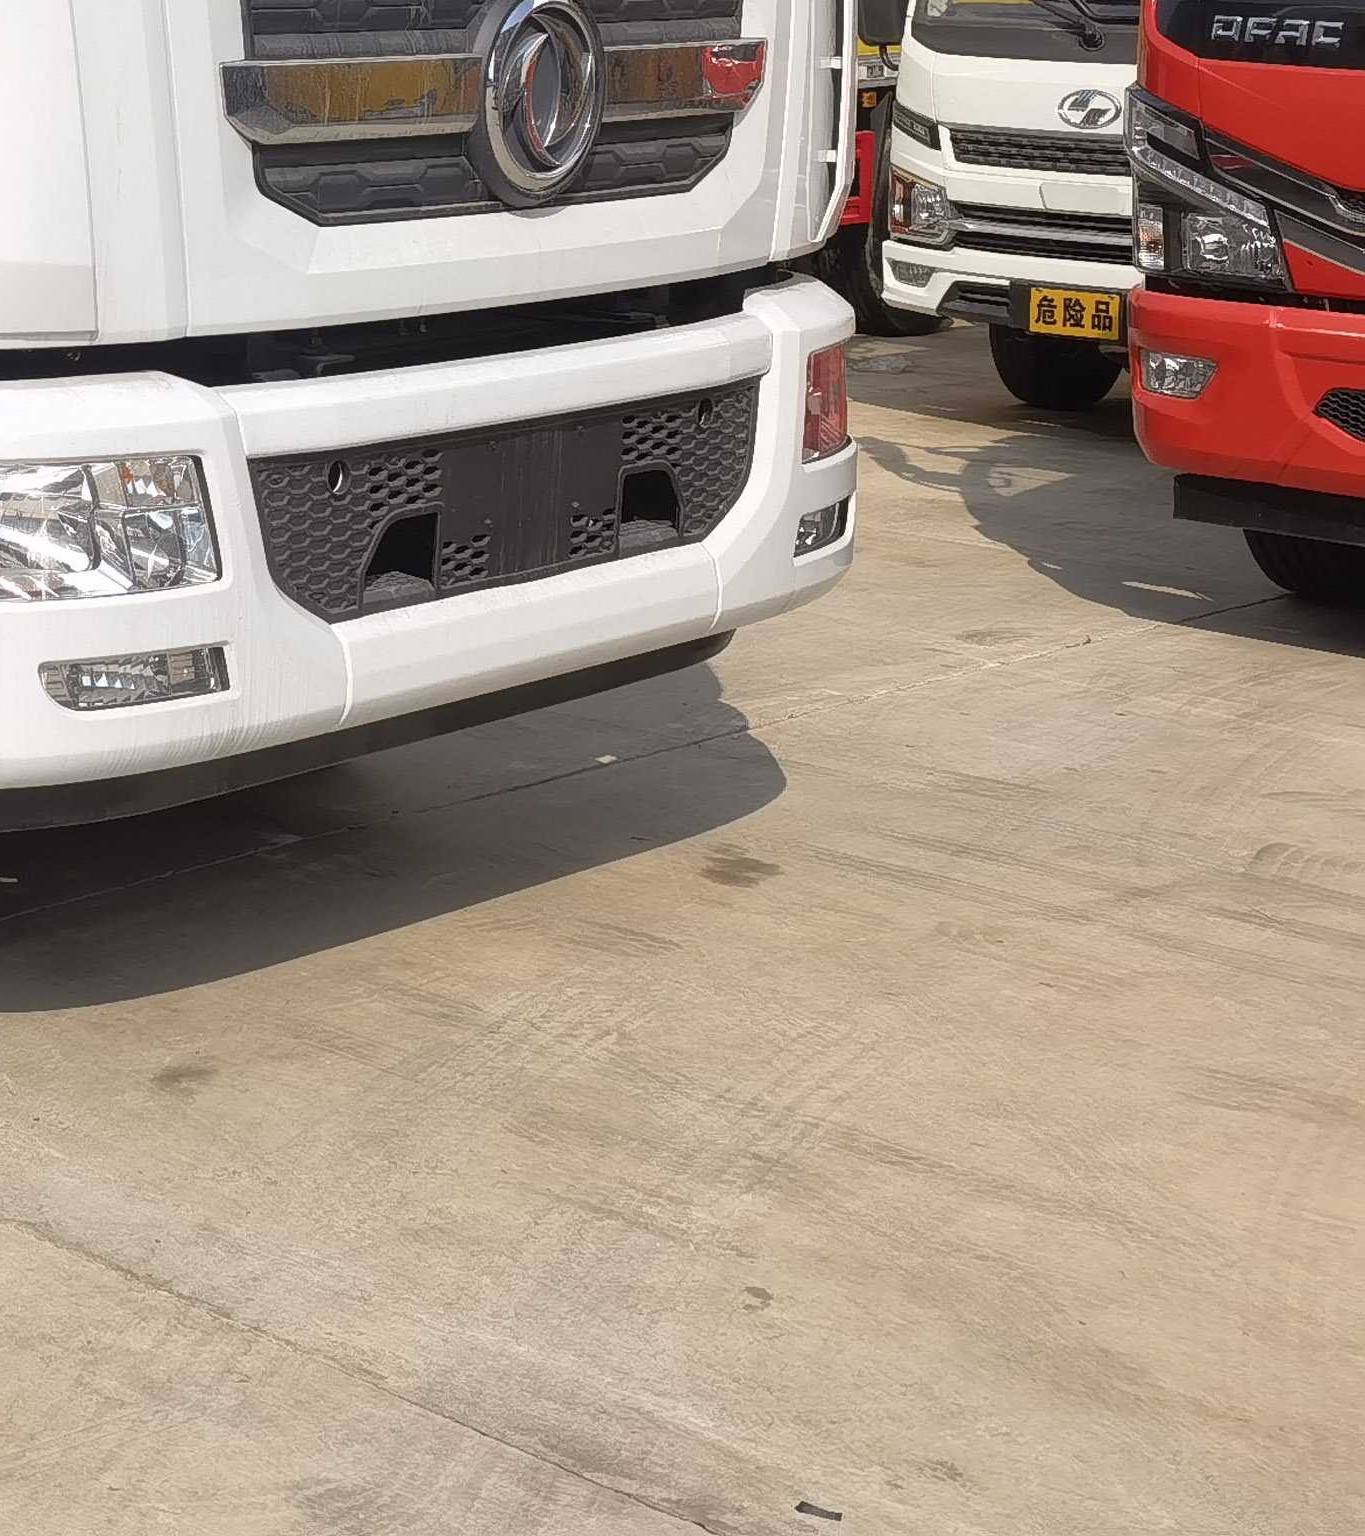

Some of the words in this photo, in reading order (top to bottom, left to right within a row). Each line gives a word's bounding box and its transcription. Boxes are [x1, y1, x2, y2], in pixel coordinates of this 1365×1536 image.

[1210, 14, 1345, 49] DFAC
[1033, 295, 1115, 332] 危险品
